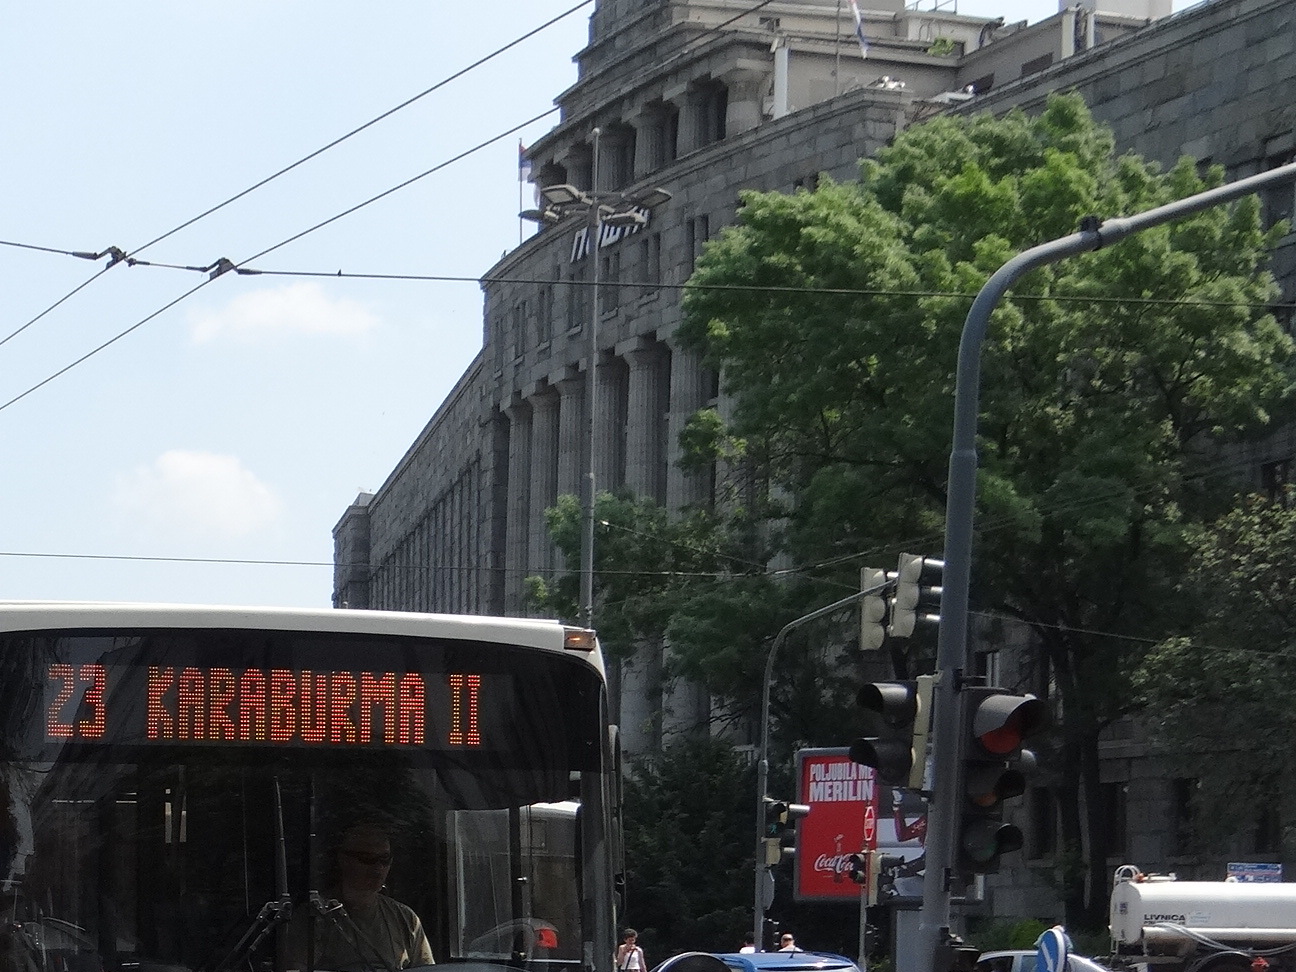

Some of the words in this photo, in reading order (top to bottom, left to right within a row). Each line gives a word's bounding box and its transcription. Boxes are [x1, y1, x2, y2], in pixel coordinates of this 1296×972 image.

[47, 664, 106, 739] 23
[147, 665, 426, 744] KARABURMA
[810, 762, 857, 782] POLJUBILA
[809, 779, 874, 802] MERILIN
